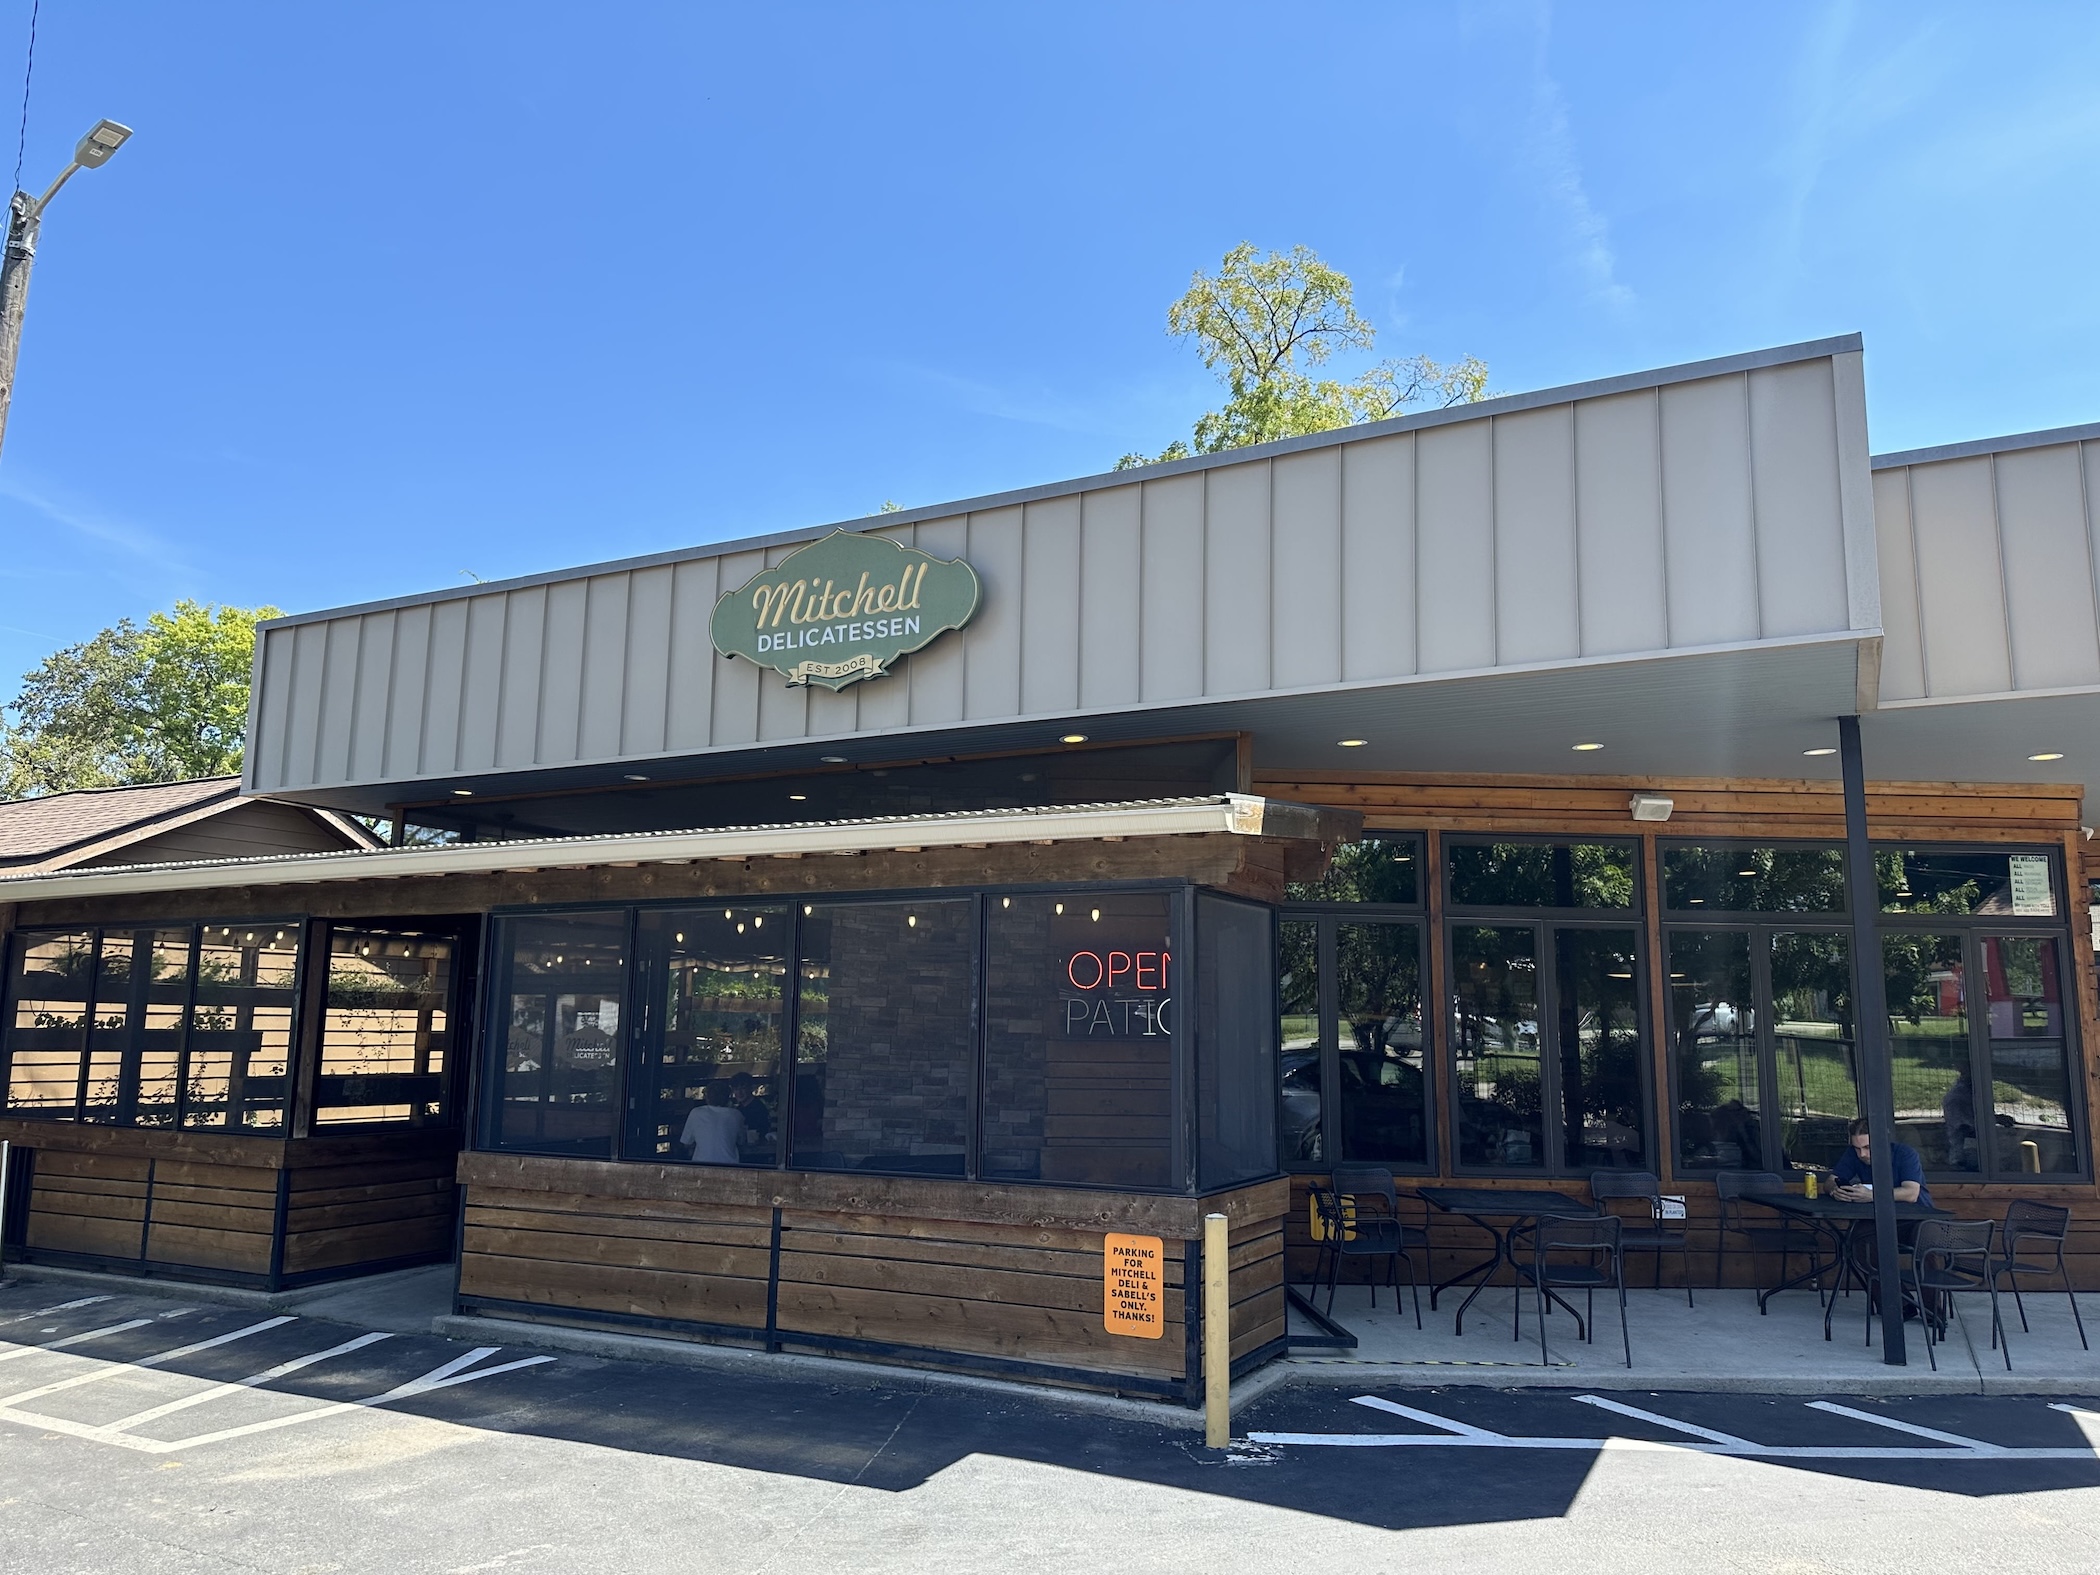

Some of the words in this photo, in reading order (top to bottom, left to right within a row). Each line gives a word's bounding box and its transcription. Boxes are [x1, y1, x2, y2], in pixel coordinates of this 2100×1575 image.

[752, 562, 929, 630] Mitchell
[757, 615, 920, 653] DELICATESSEN
[806, 663, 830, 675] EST
[835, 657, 866, 675] 2008
[1113, 1247, 1155, 1258] PARKING
[1124, 1259, 1143, 1268] FOR
[1111, 1268, 1156, 1280] MITCHELL
[1118, 1279, 1139, 1289] DELI
[1142, 1281, 1148, 1290] &
[1111, 1289, 1156, 1301] SABELL'S
[1120, 1301, 1147, 1311] ONLY.
[1112, 1310, 1155, 1323] THANKS!
